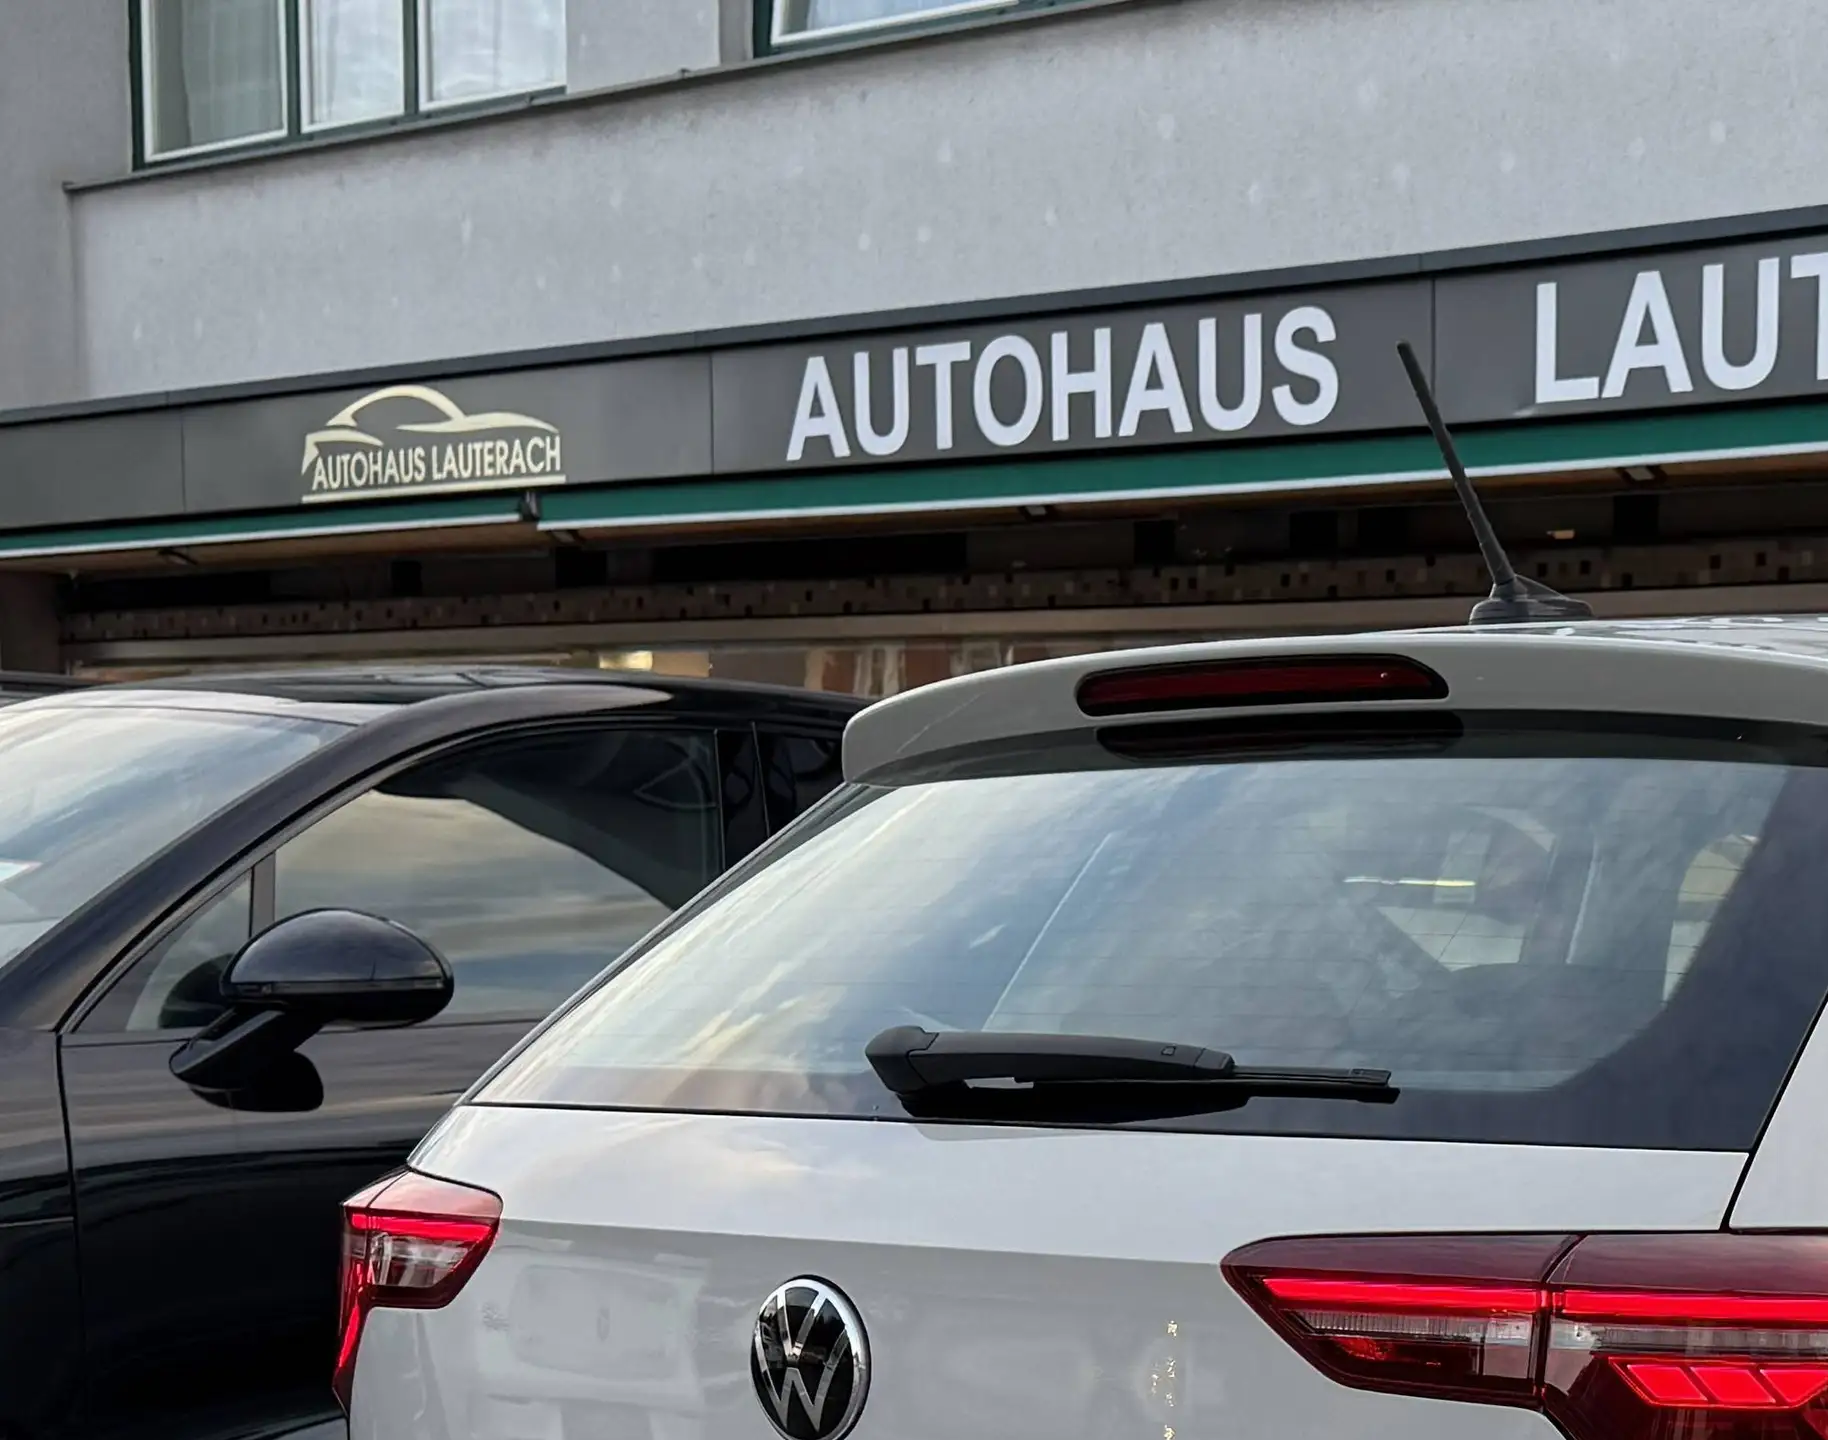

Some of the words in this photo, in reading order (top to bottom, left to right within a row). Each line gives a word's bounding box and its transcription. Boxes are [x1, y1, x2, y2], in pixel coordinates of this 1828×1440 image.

[785, 306, 1339, 462] AUTOHAUS
[312, 446, 426, 491] AUTOHAUS
[432, 436, 562, 481] LAUTERACH
